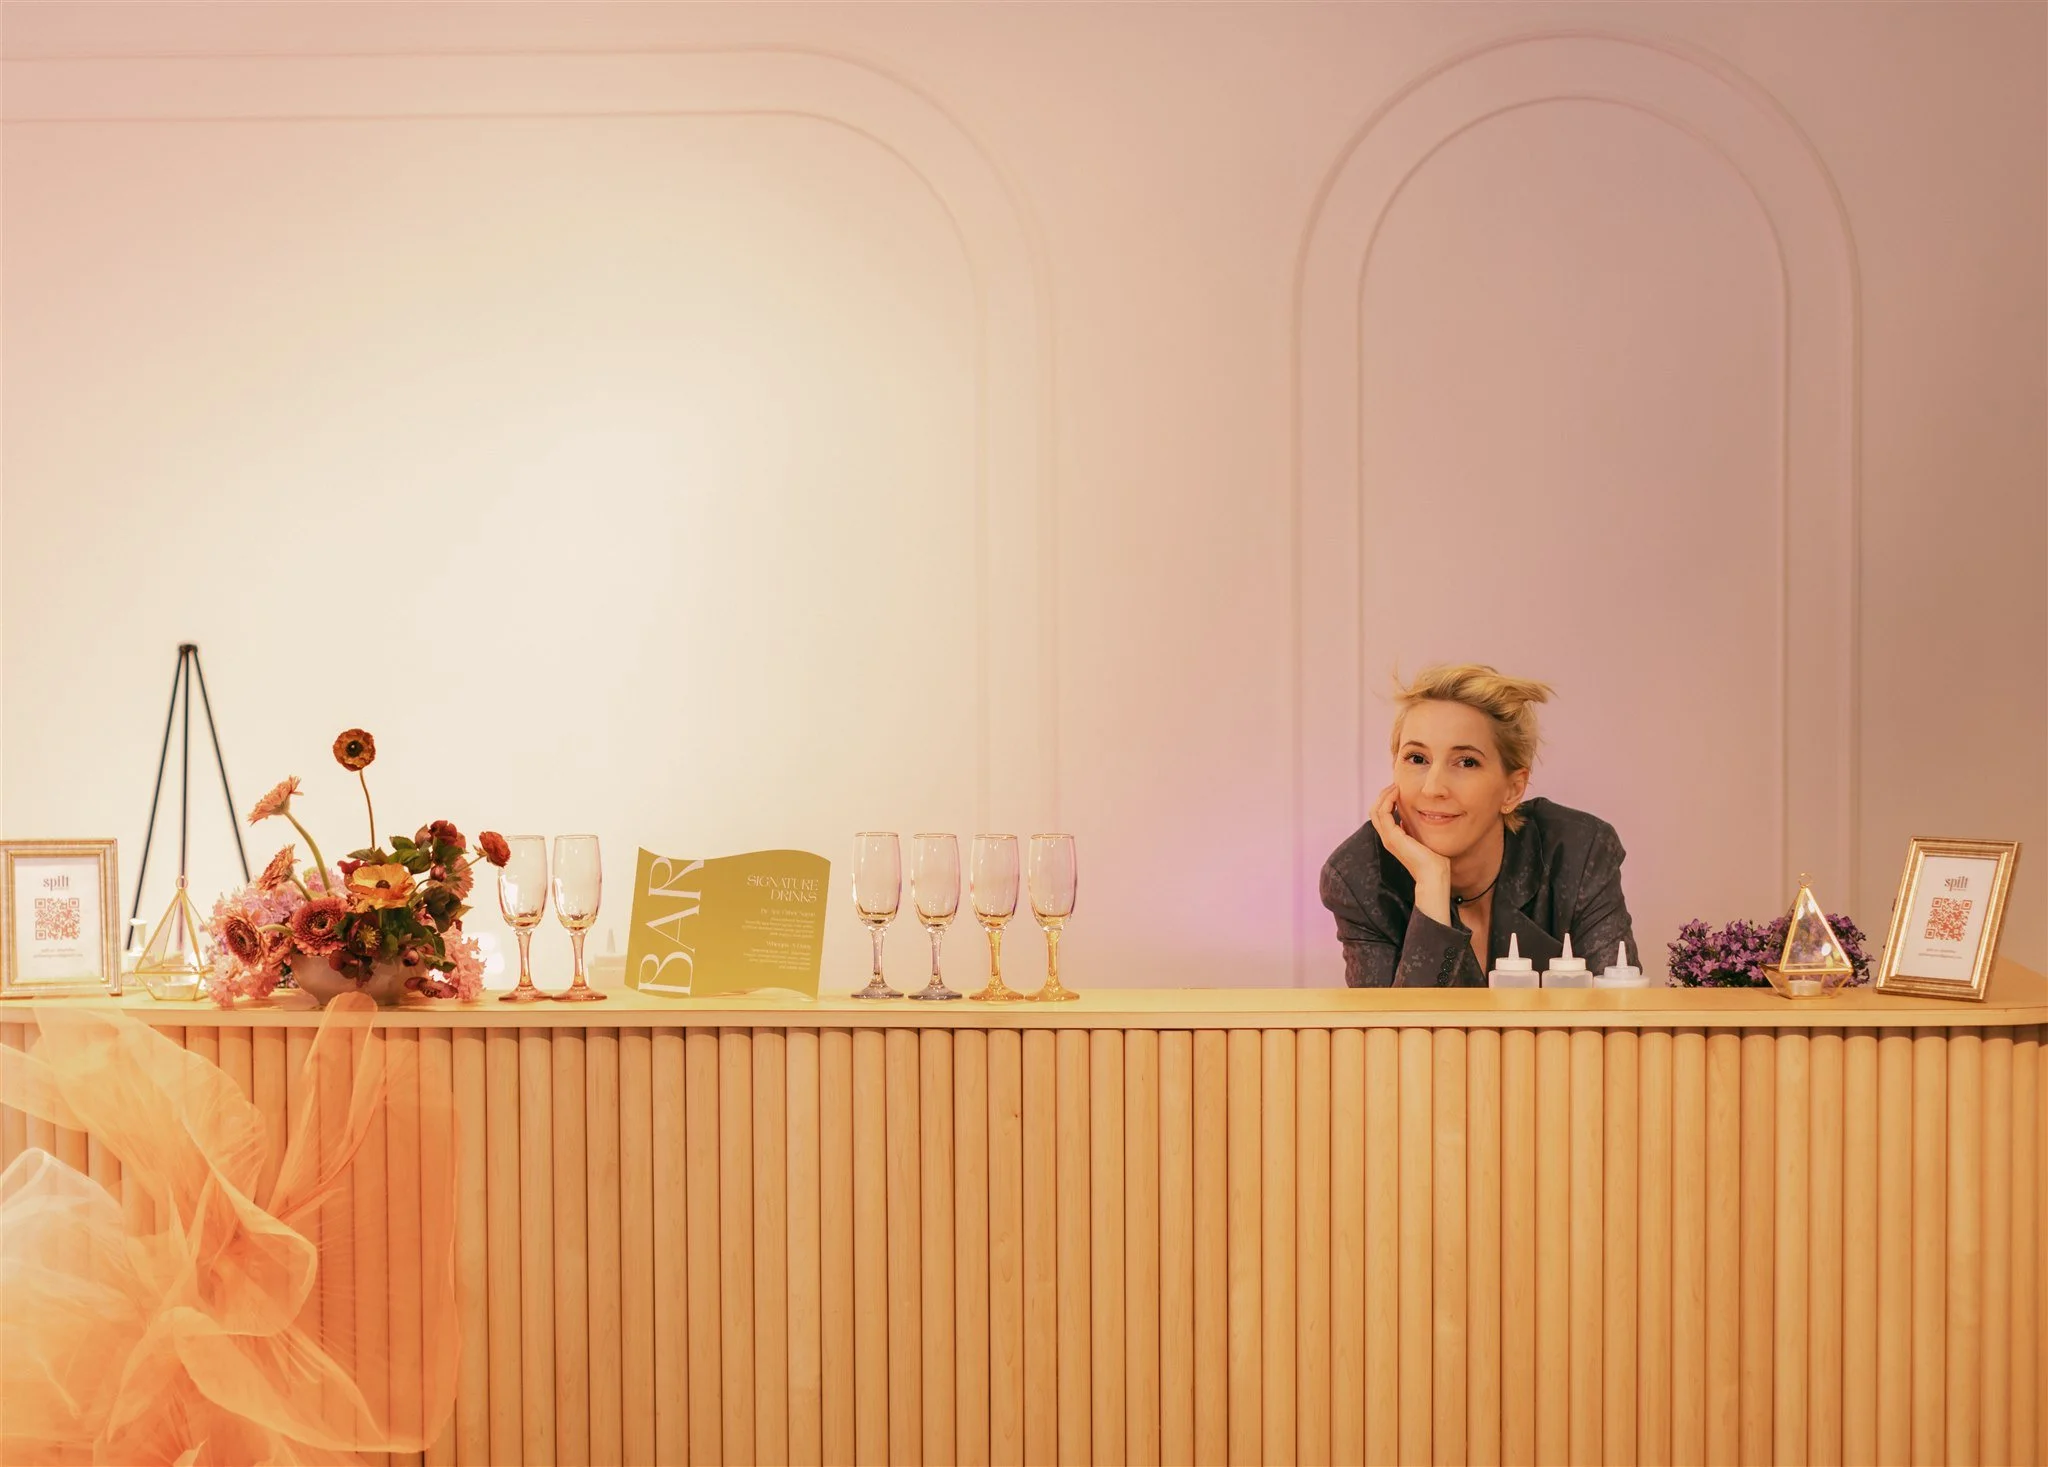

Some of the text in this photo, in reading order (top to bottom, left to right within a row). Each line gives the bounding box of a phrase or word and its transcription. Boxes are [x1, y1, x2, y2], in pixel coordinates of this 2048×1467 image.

[43, 875, 69, 891] spilt
[747, 875, 819, 891] SIGNATURE
[1944, 876, 1968, 892] spilt
[770, 888, 817, 903] DRINKS
[638, 857, 704, 996] BAR
